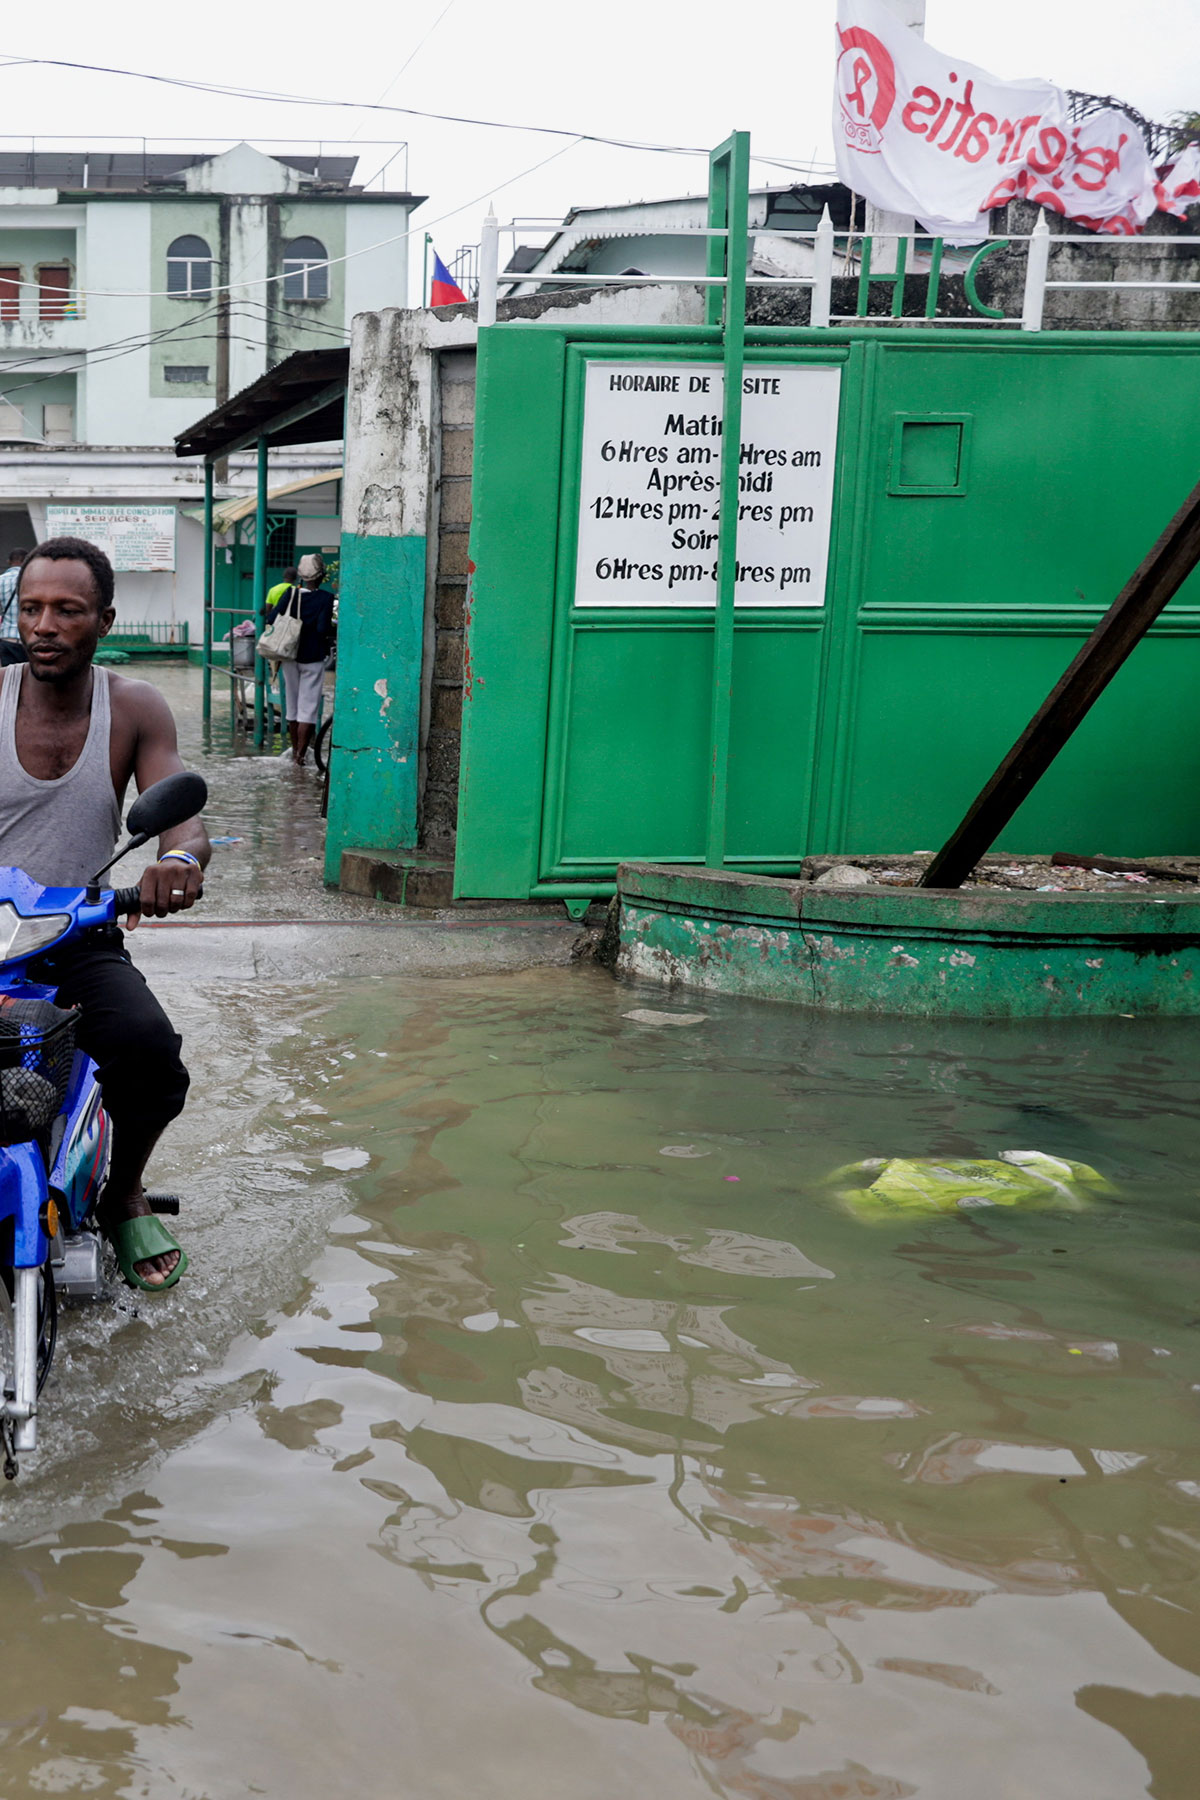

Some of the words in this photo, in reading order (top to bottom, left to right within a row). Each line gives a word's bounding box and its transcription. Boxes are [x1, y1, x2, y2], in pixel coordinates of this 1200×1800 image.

[857, 237, 1009, 319] HIC
[609, 374, 680, 393] HORAIRE
[689, 376, 711, 393] DE
[791, 450, 821, 467] am
[647, 467, 774, 497] Après-idi
[84, 515, 140, 523] SERVICES
[780, 505, 814, 530] pm
[780, 566, 811, 590] pm
